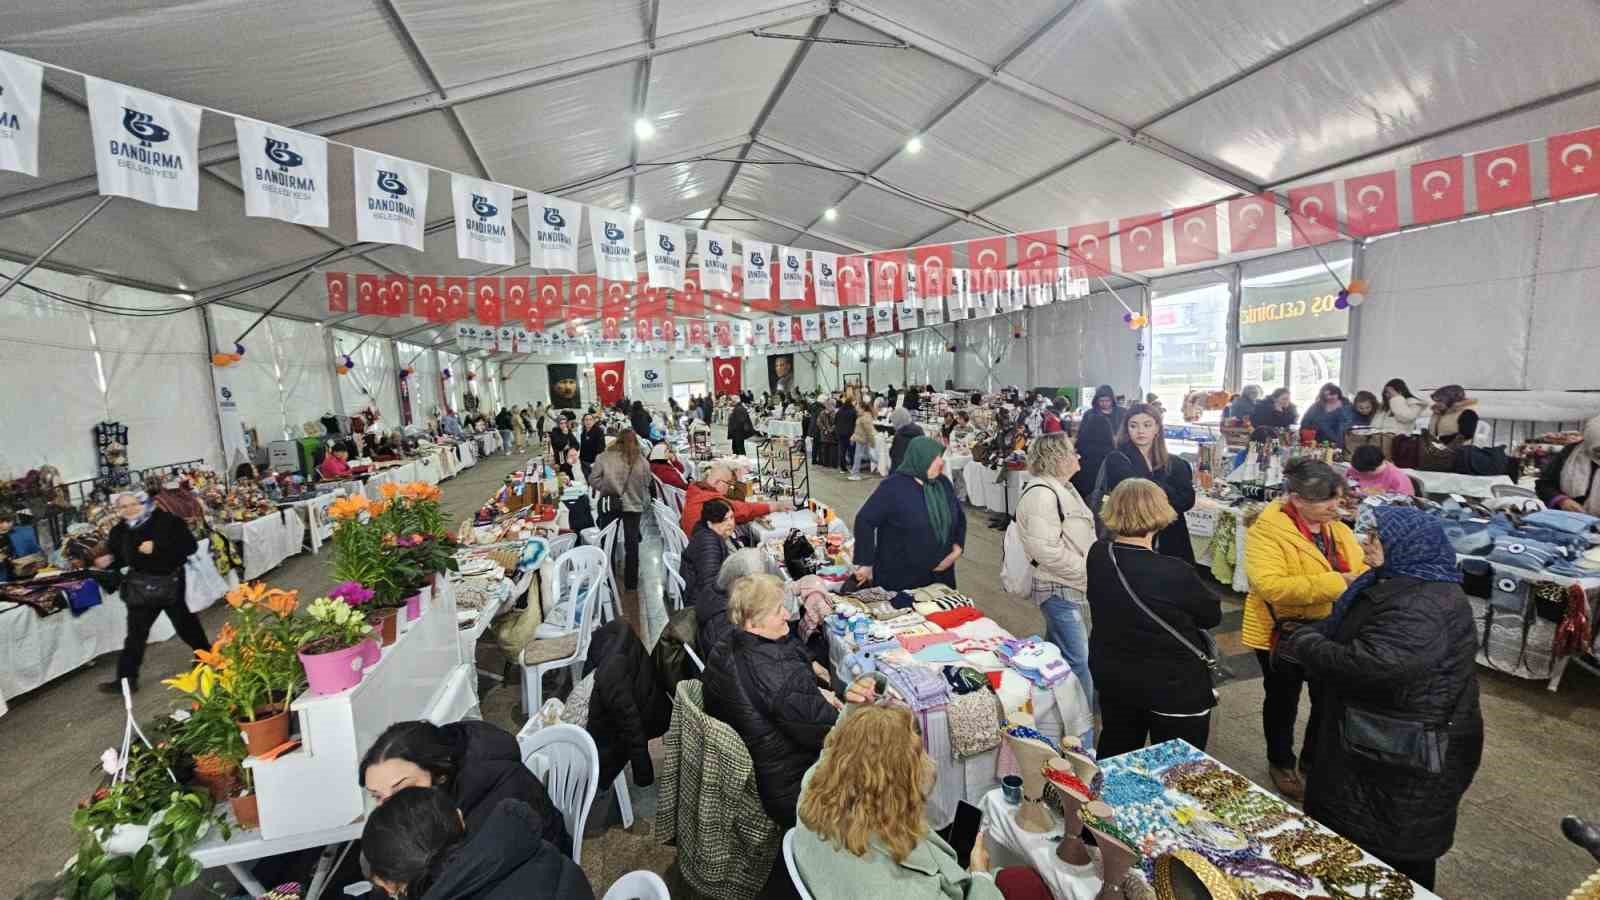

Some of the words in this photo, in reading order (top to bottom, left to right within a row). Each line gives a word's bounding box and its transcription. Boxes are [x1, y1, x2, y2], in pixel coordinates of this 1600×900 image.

[110, 140, 183, 170] BANDIRMA
[255, 167, 316, 192] BANDIRMA
[368, 197, 415, 219] BANDIRMA
[466, 218, 506, 237] BANDIRMA
